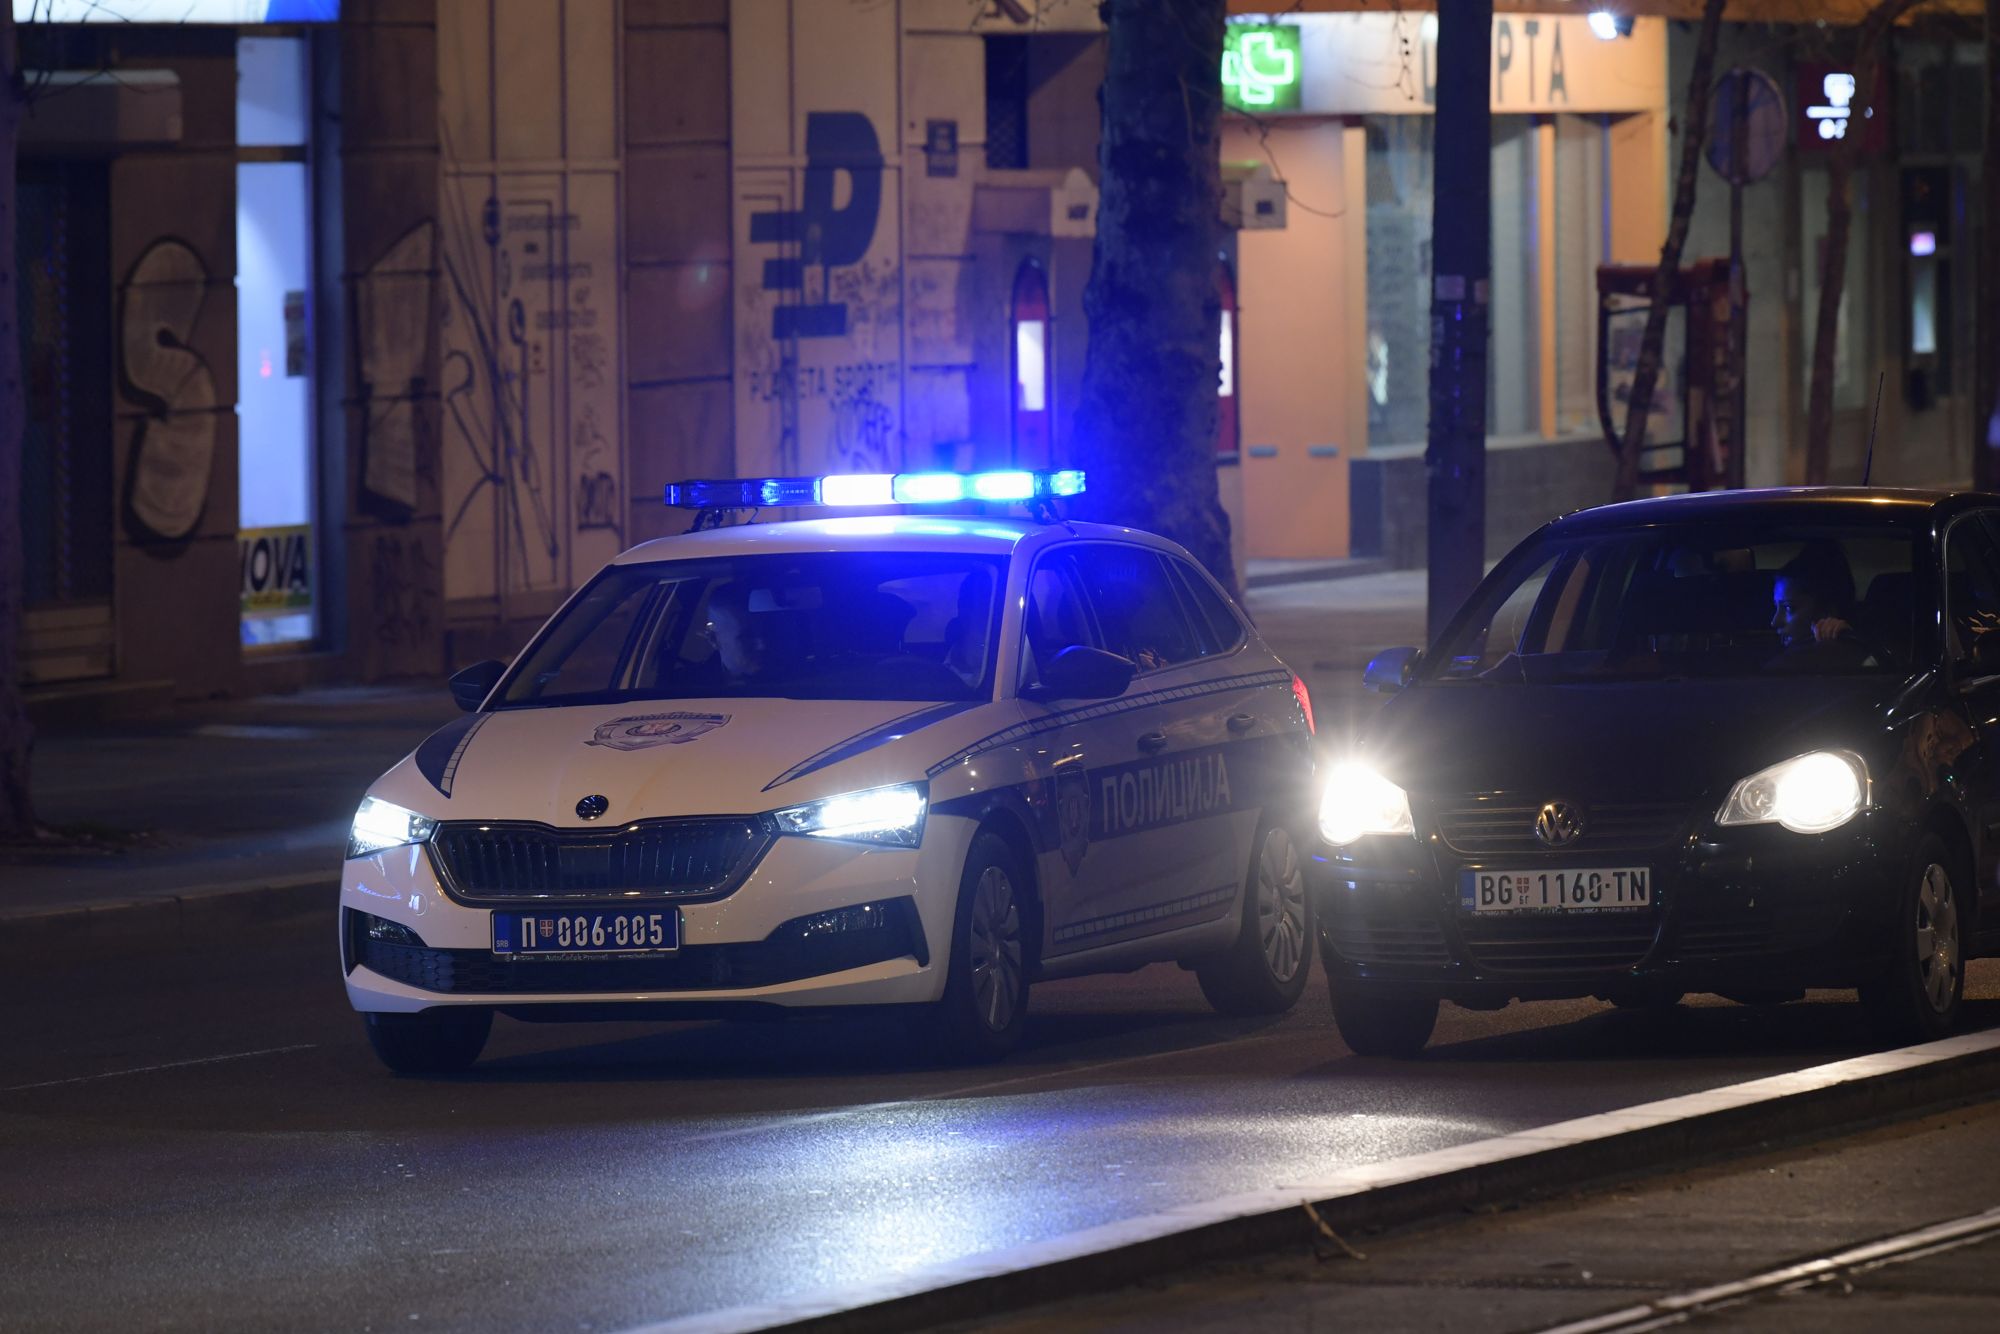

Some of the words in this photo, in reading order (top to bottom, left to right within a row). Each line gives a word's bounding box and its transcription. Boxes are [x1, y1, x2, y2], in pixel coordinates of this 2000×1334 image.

[1102, 753, 1231, 833] ПОЛИЦИЈА
[1480, 875, 1513, 906] BG
[496, 940, 509, 948] SRB
[521, 917, 536, 948] П
